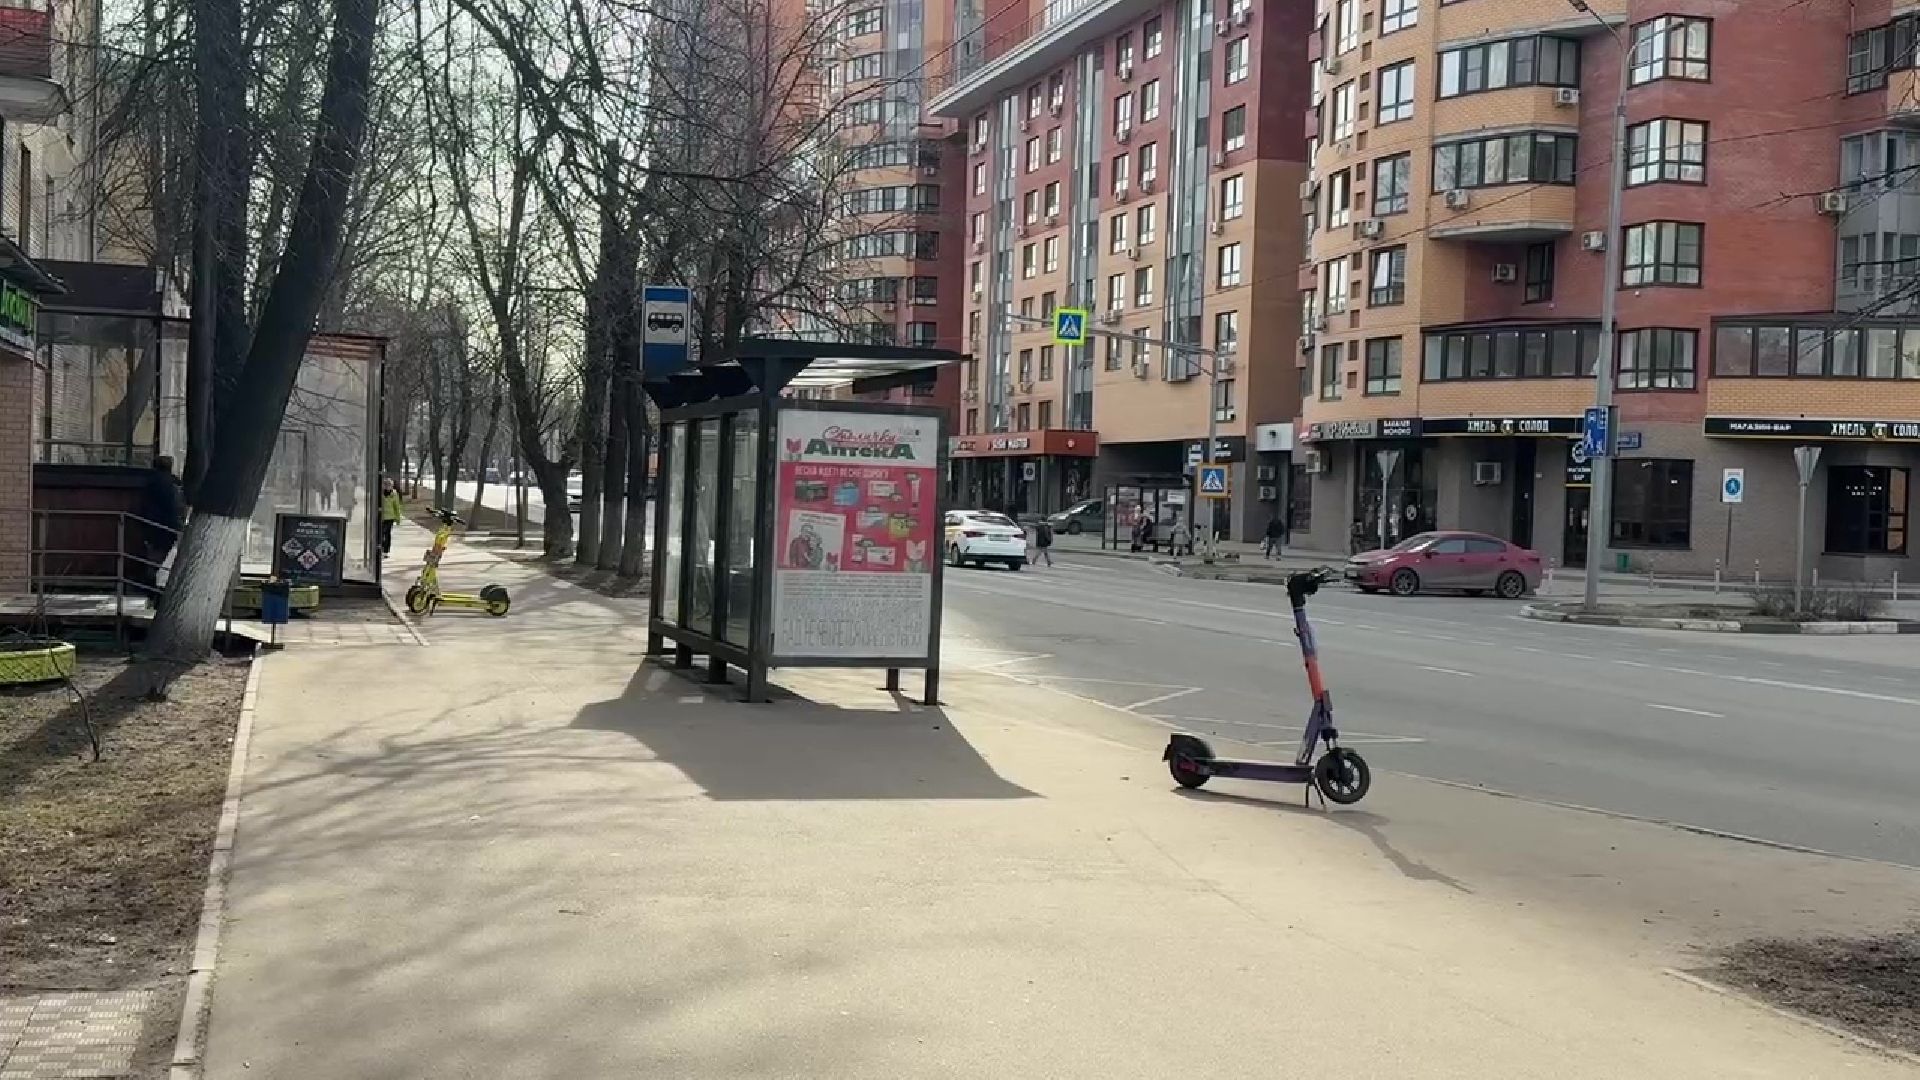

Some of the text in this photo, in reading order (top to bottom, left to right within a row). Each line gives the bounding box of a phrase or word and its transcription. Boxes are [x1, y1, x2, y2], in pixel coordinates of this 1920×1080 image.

[1467, 419, 1549, 433] ХМЕЛЬ СОЛОД
[1830, 422, 1920, 437] ХМЕЛЬ СОЛО
